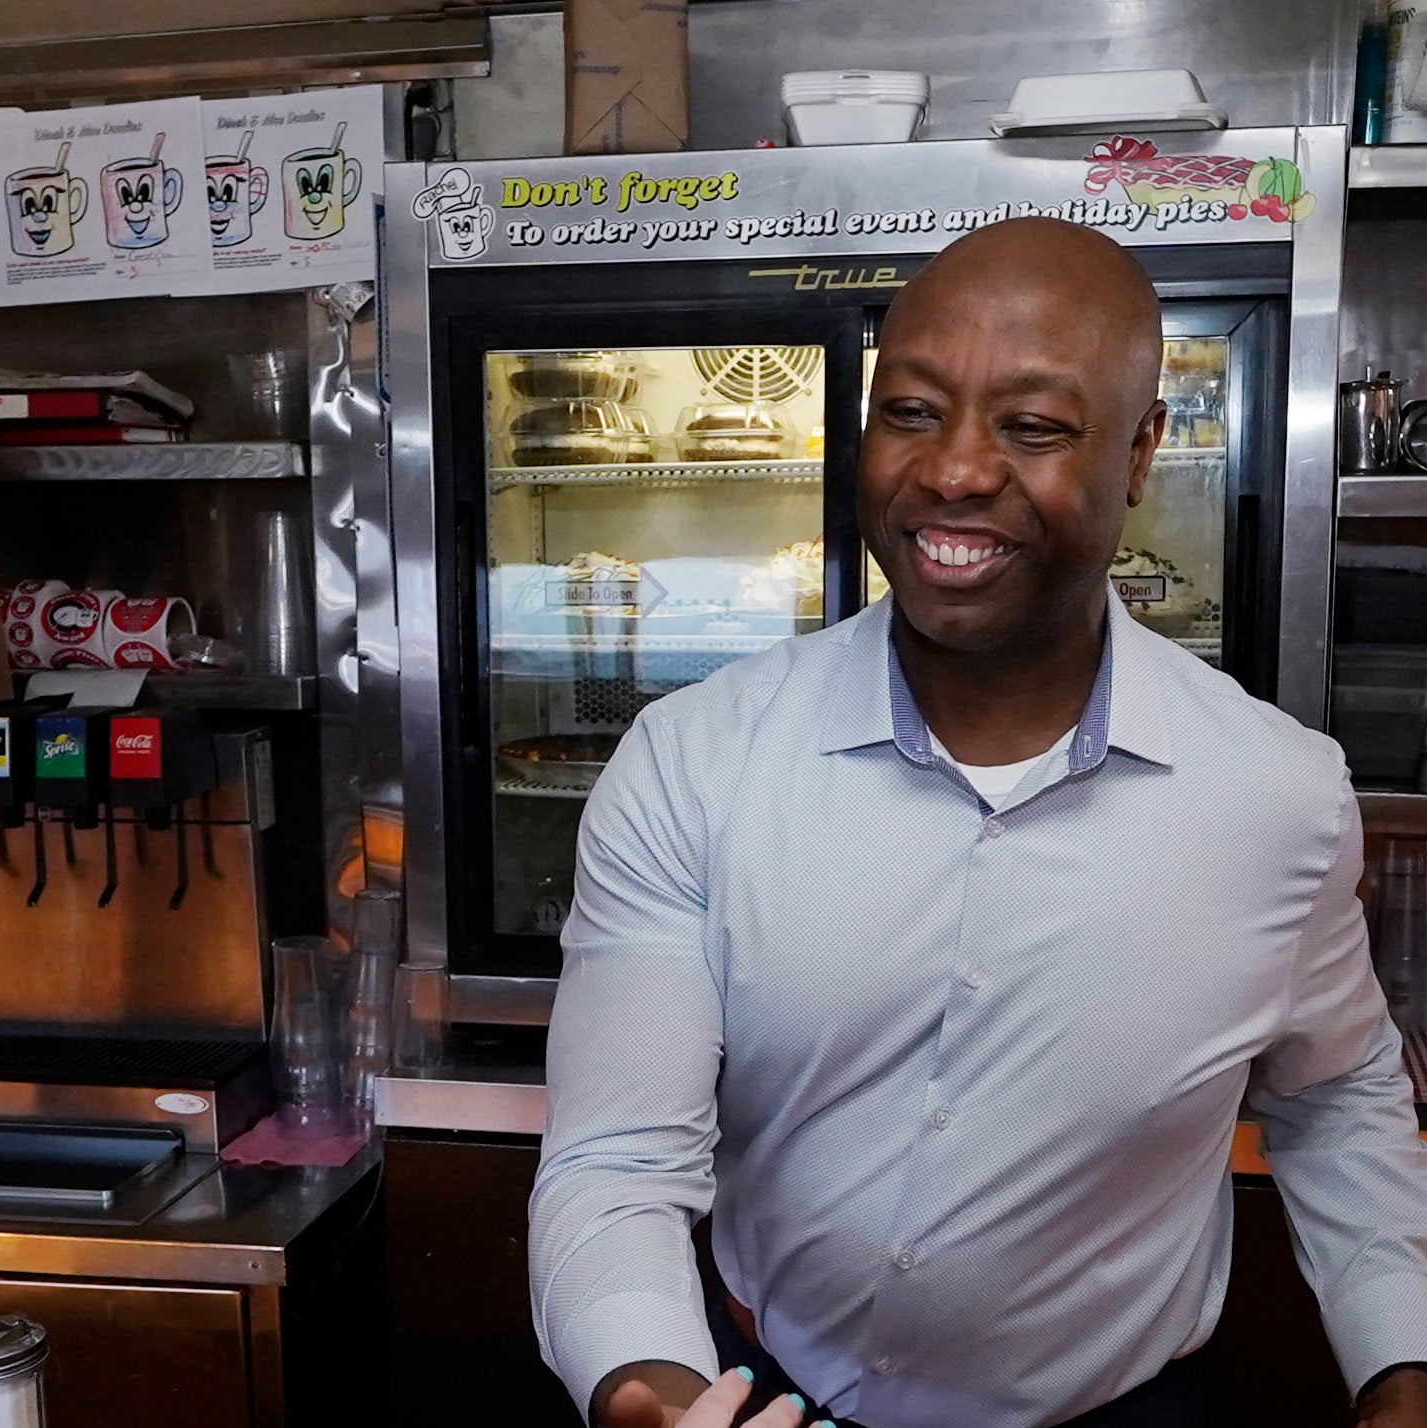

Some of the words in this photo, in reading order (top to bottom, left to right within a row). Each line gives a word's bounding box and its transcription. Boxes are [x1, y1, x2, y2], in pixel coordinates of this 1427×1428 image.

[500, 176, 608, 209] Don't
[616, 171, 740, 213] forget
[505, 218, 545, 247] To
[549, 216, 637, 245] order
[640, 216, 718, 249] your
[723, 208, 838, 248] special
[845, 205, 936, 235] event
[942, 201, 1011, 231] and
[1155, 194, 1230, 229] pies
[794, 264, 909, 291] true
[557, 586, 585, 600] Slide
[588, 586, 600, 600] To
[603, 586, 634, 602] Open
[1119, 582, 1152, 599] Open
[43, 740, 76, 760] Sprite
